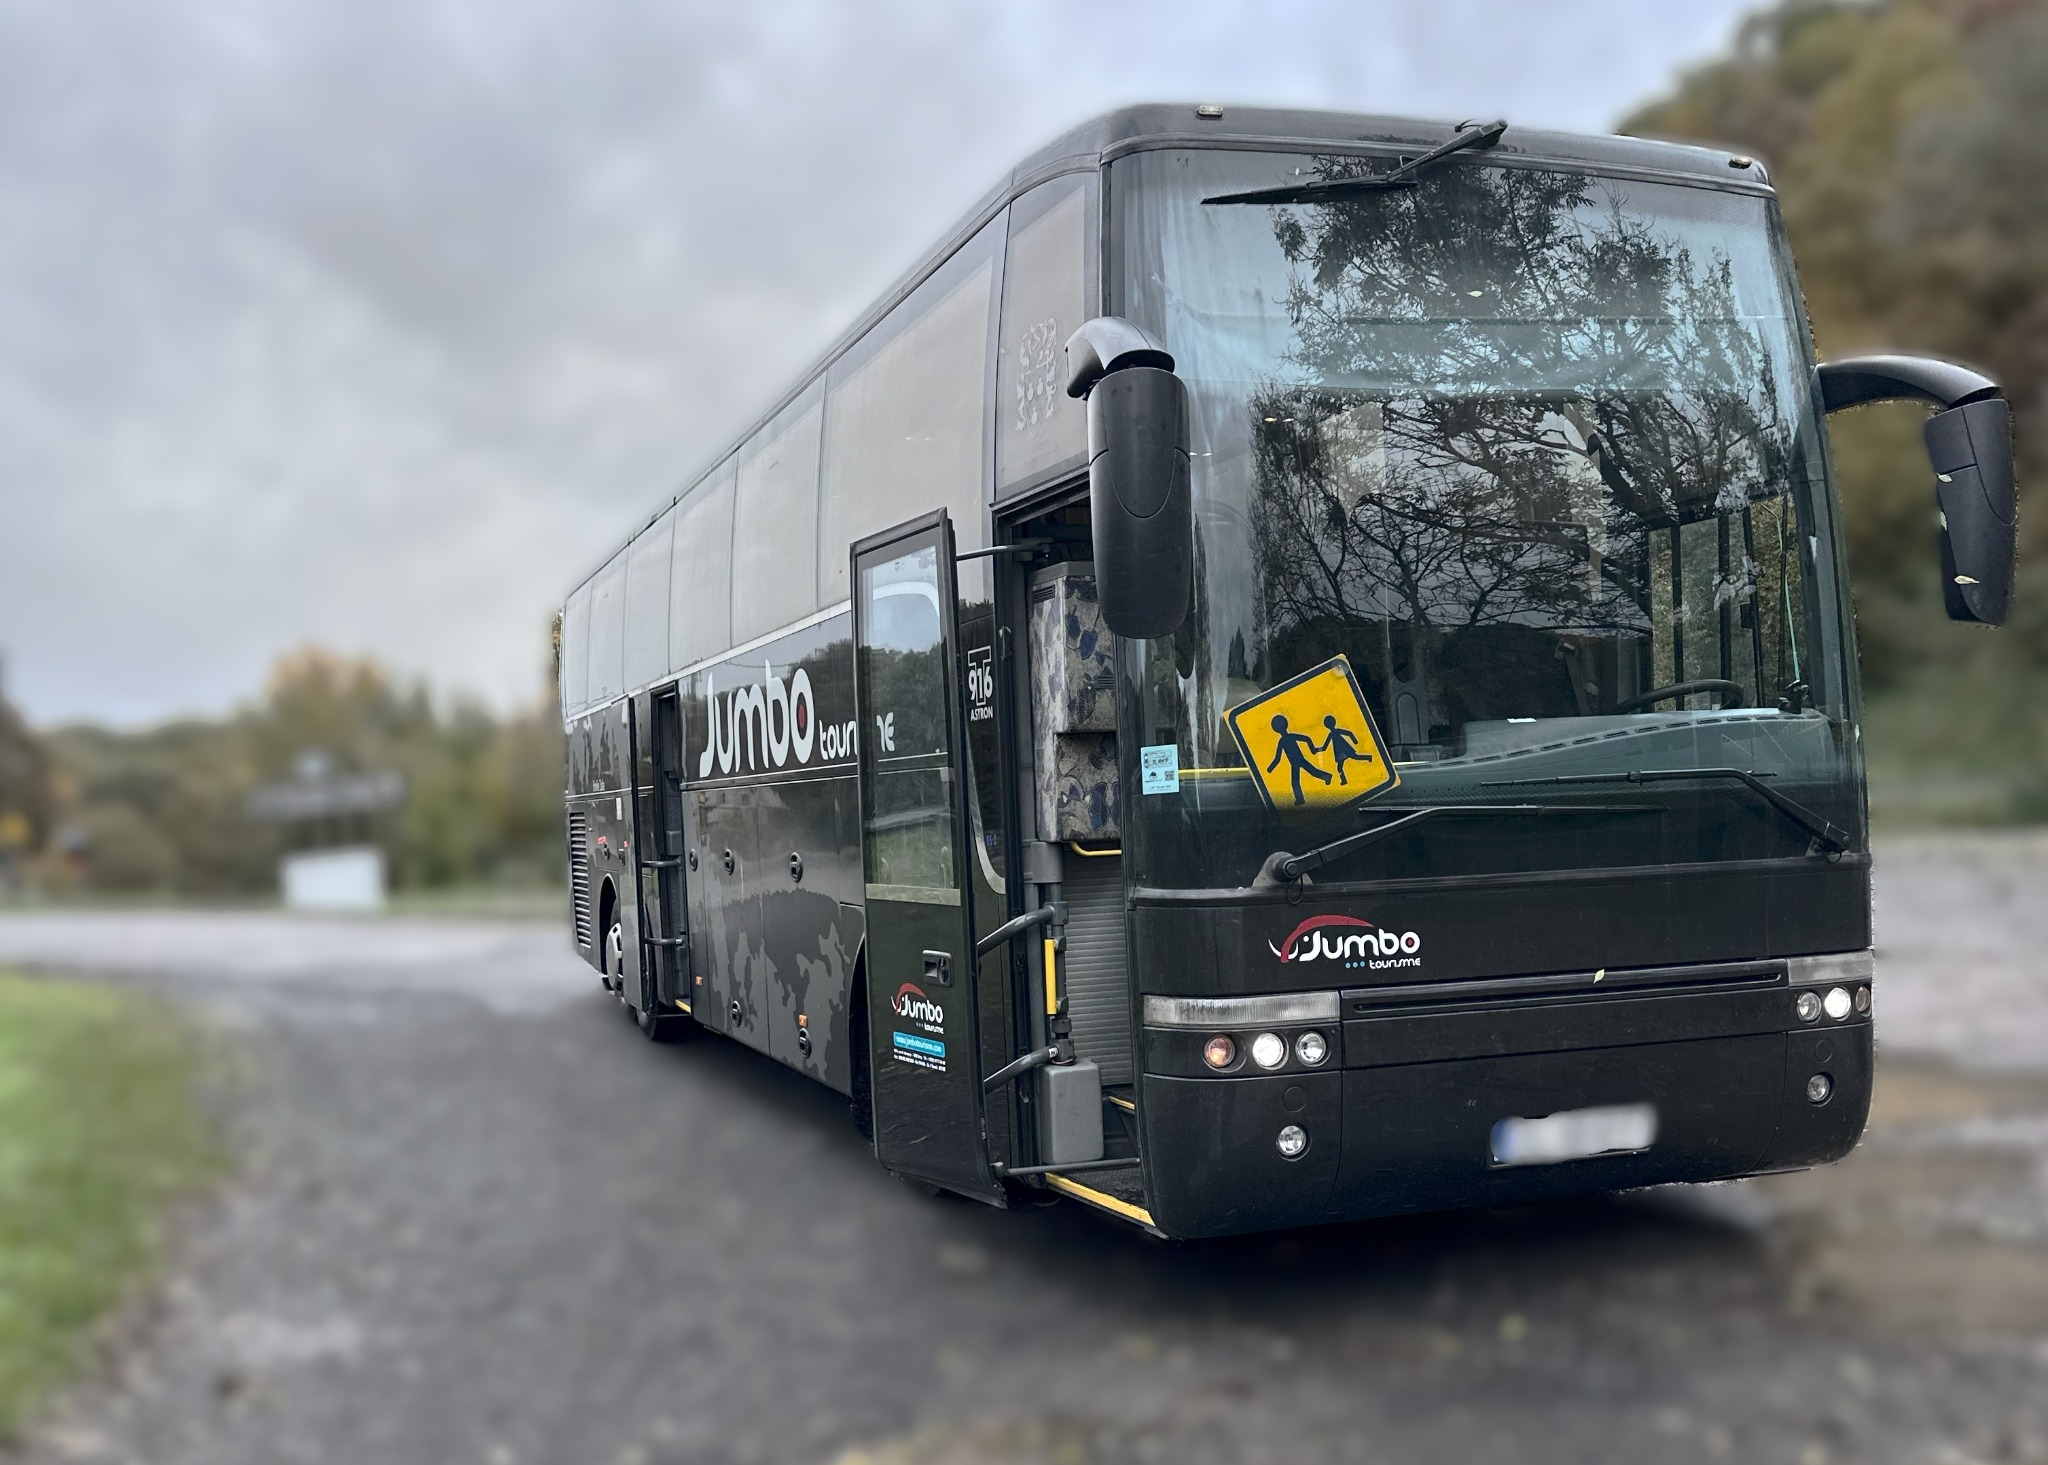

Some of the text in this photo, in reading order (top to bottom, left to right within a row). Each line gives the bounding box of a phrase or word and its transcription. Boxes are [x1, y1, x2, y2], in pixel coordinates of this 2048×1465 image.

[699, 658, 815, 778] Jumbo
[970, 706, 994, 722] ASTRON
[1299, 928, 1421, 962] Jumbo
[1369, 957, 1421, 970] tourisme
[900, 994, 944, 1024] Jumbo
